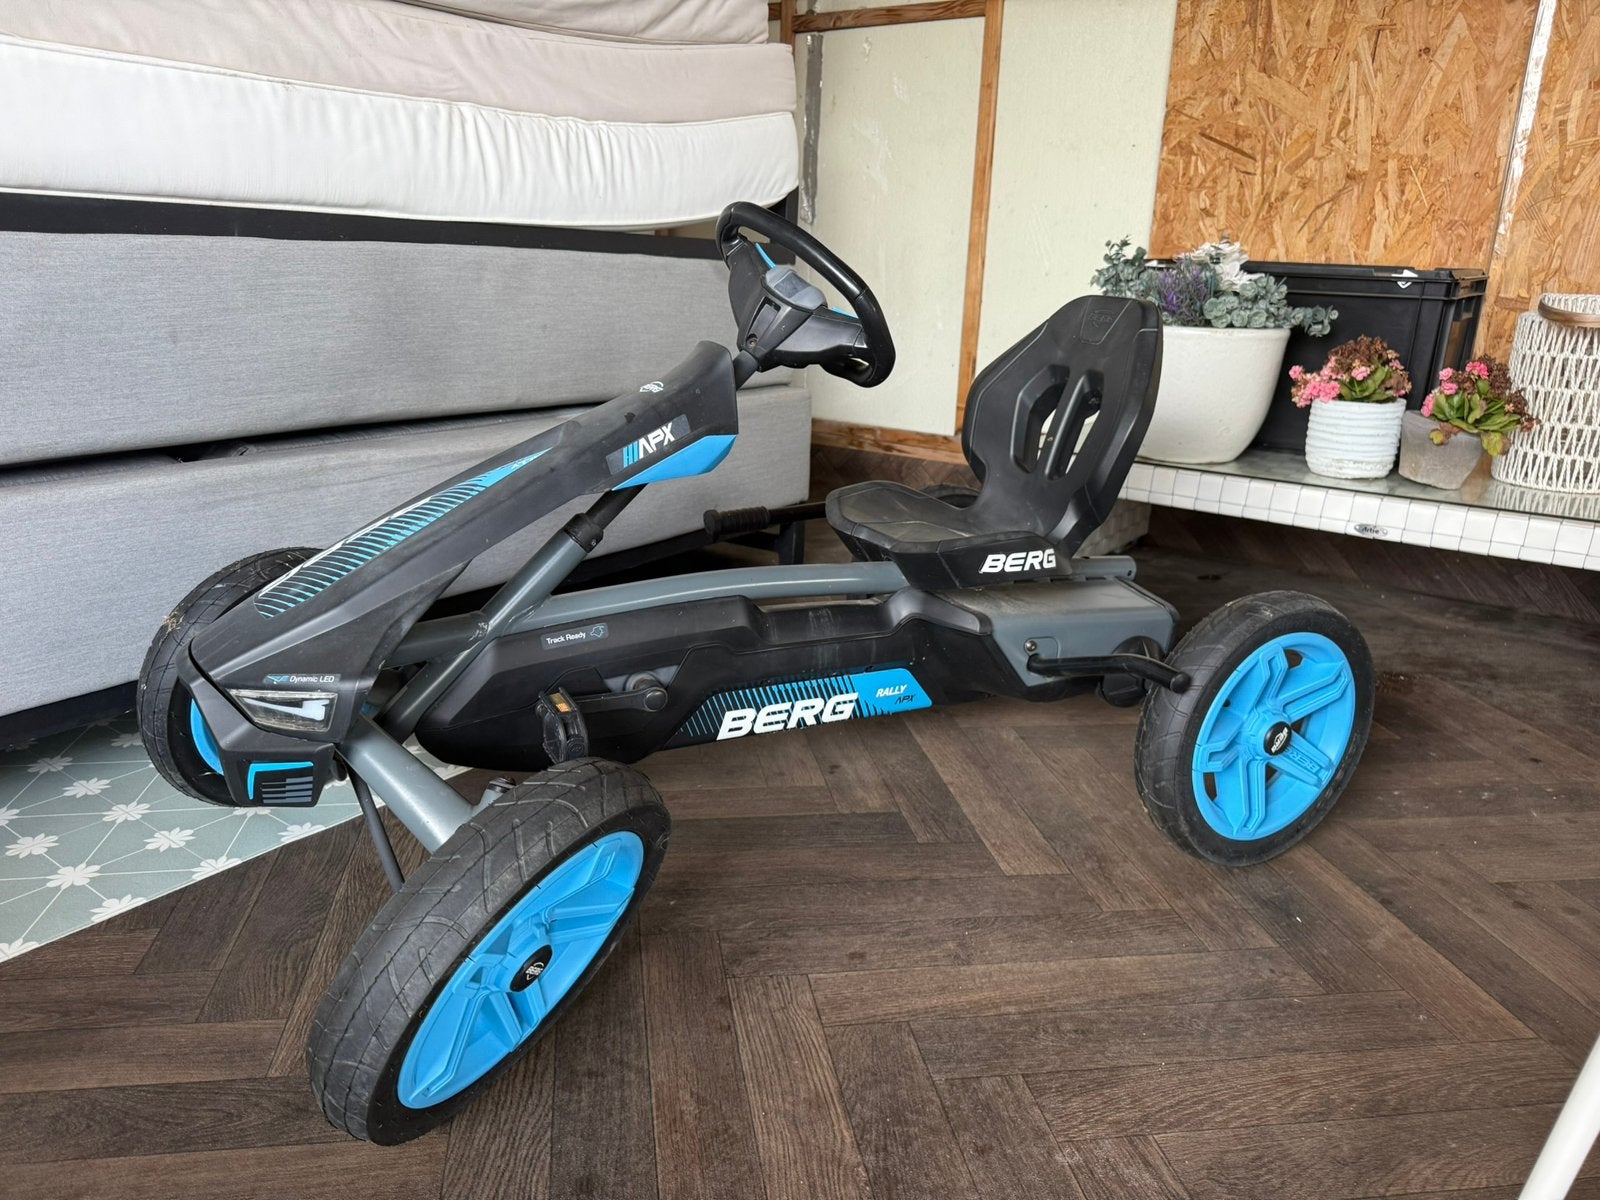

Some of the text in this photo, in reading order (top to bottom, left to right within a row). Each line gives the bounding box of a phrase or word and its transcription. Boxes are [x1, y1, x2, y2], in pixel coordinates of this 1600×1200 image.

[979, 548, 1057, 573] BERG
[546, 631, 586, 645] Track Ready
[289, 675, 335, 684] Dynamic LED
[875, 684, 907, 698] RALLY
[894, 694, 917, 705] APX
[716, 692, 859, 741] BERG
